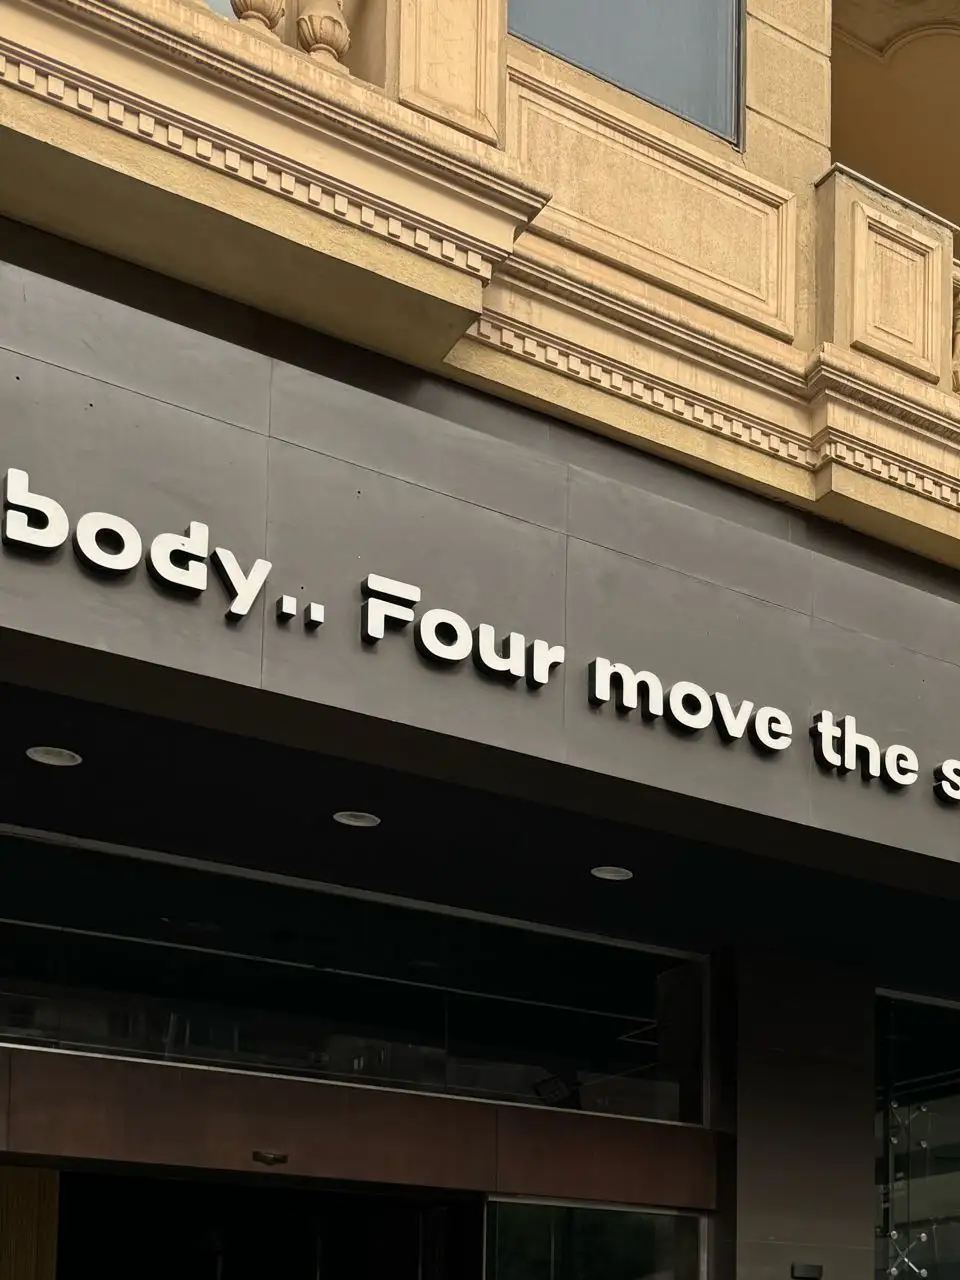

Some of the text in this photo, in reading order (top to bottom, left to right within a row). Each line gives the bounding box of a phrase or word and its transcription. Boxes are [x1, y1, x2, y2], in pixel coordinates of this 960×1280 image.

[3, 467, 325, 628] body..
[362, 573, 565, 688] Four
[589, 657, 793, 752] move
[810, 709, 919, 786] the
